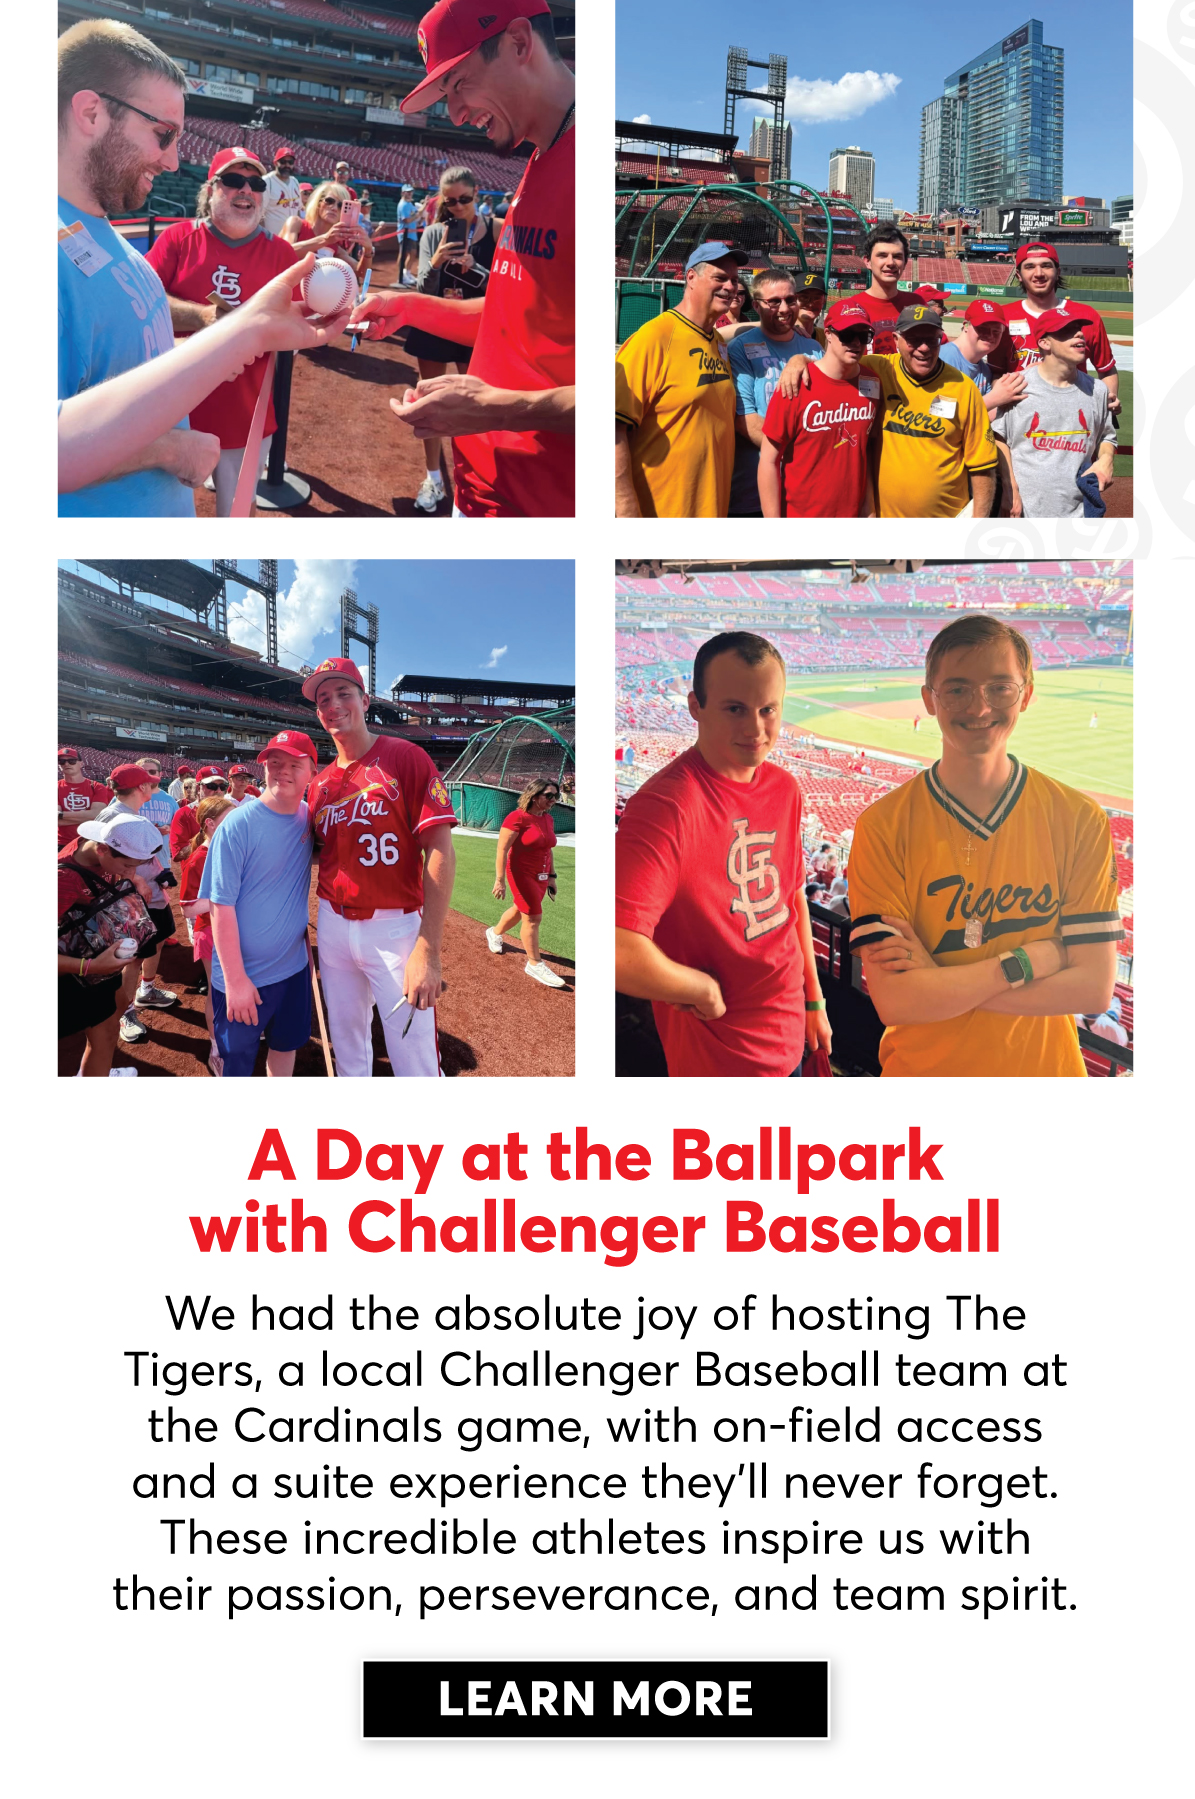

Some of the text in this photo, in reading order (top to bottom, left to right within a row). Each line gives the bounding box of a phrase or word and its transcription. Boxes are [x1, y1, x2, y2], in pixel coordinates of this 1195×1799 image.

[962, 206, 977, 215] Ford
[1064, 213, 1083, 222] Sprite
[886, 394, 945, 434] Tigers
[320, 792, 389, 837] The Lou
[358, 832, 399, 867] 36
[927, 874, 1060, 934] Tigers
